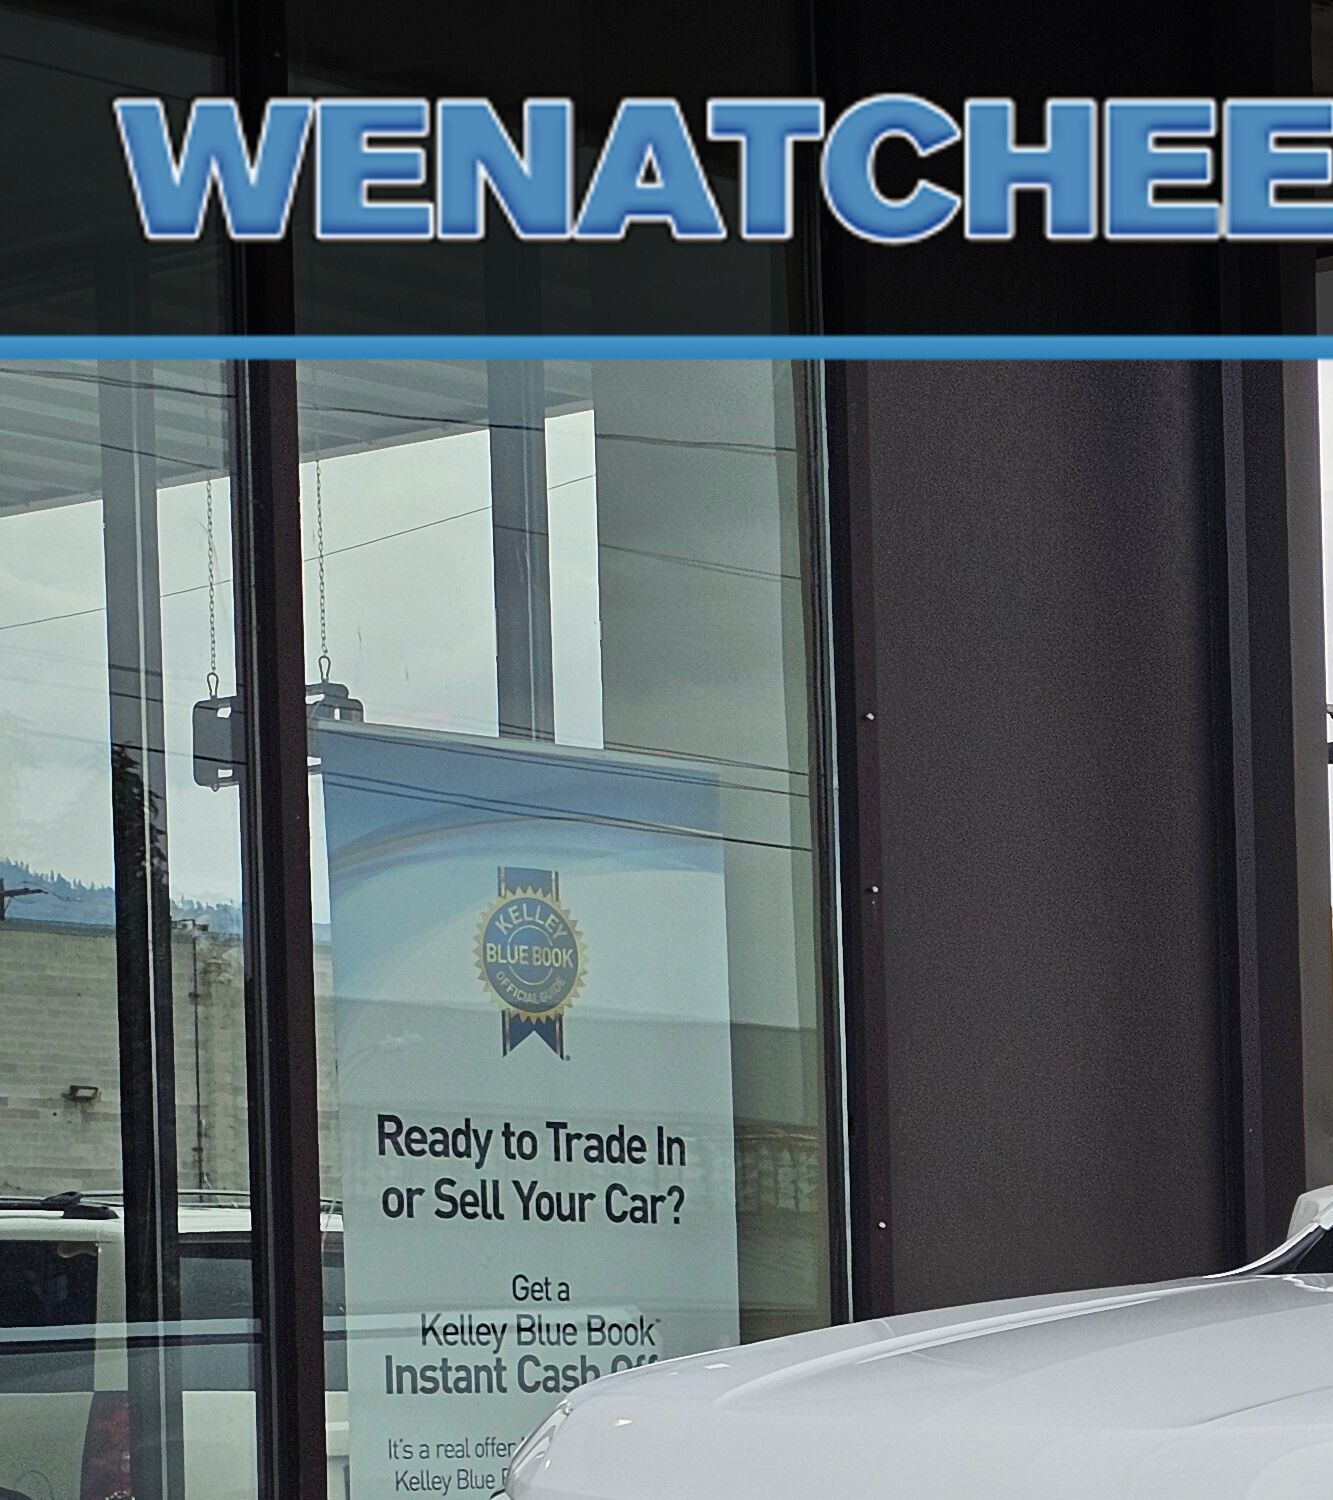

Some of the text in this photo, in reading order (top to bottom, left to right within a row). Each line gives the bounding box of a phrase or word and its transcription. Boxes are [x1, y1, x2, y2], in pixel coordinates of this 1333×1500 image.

[495, 904, 567, 938] KELLEY
[486, 942, 574, 968] BLUE BOOK
[496, 971, 540, 1004] OFFICIAL
[377, 1113, 686, 1170] Ready to Trade In
[381, 1177, 685, 1225] or Sell Your Car?
[512, 1274, 570, 1301] Get a
[421, 1313, 656, 1354] Kelley Blue Book
[385, 1355, 508, 1395] Instant
[517, 1355, 600, 1393] Cash
[388, 1438, 414, 1460] It's
[419, 1444, 430, 1459] a
[436, 1437, 471, 1458] real
[475, 1436, 516, 1458] offer
[395, 1469, 452, 1496] Kelley
[457, 1468, 496, 1490] Blue
